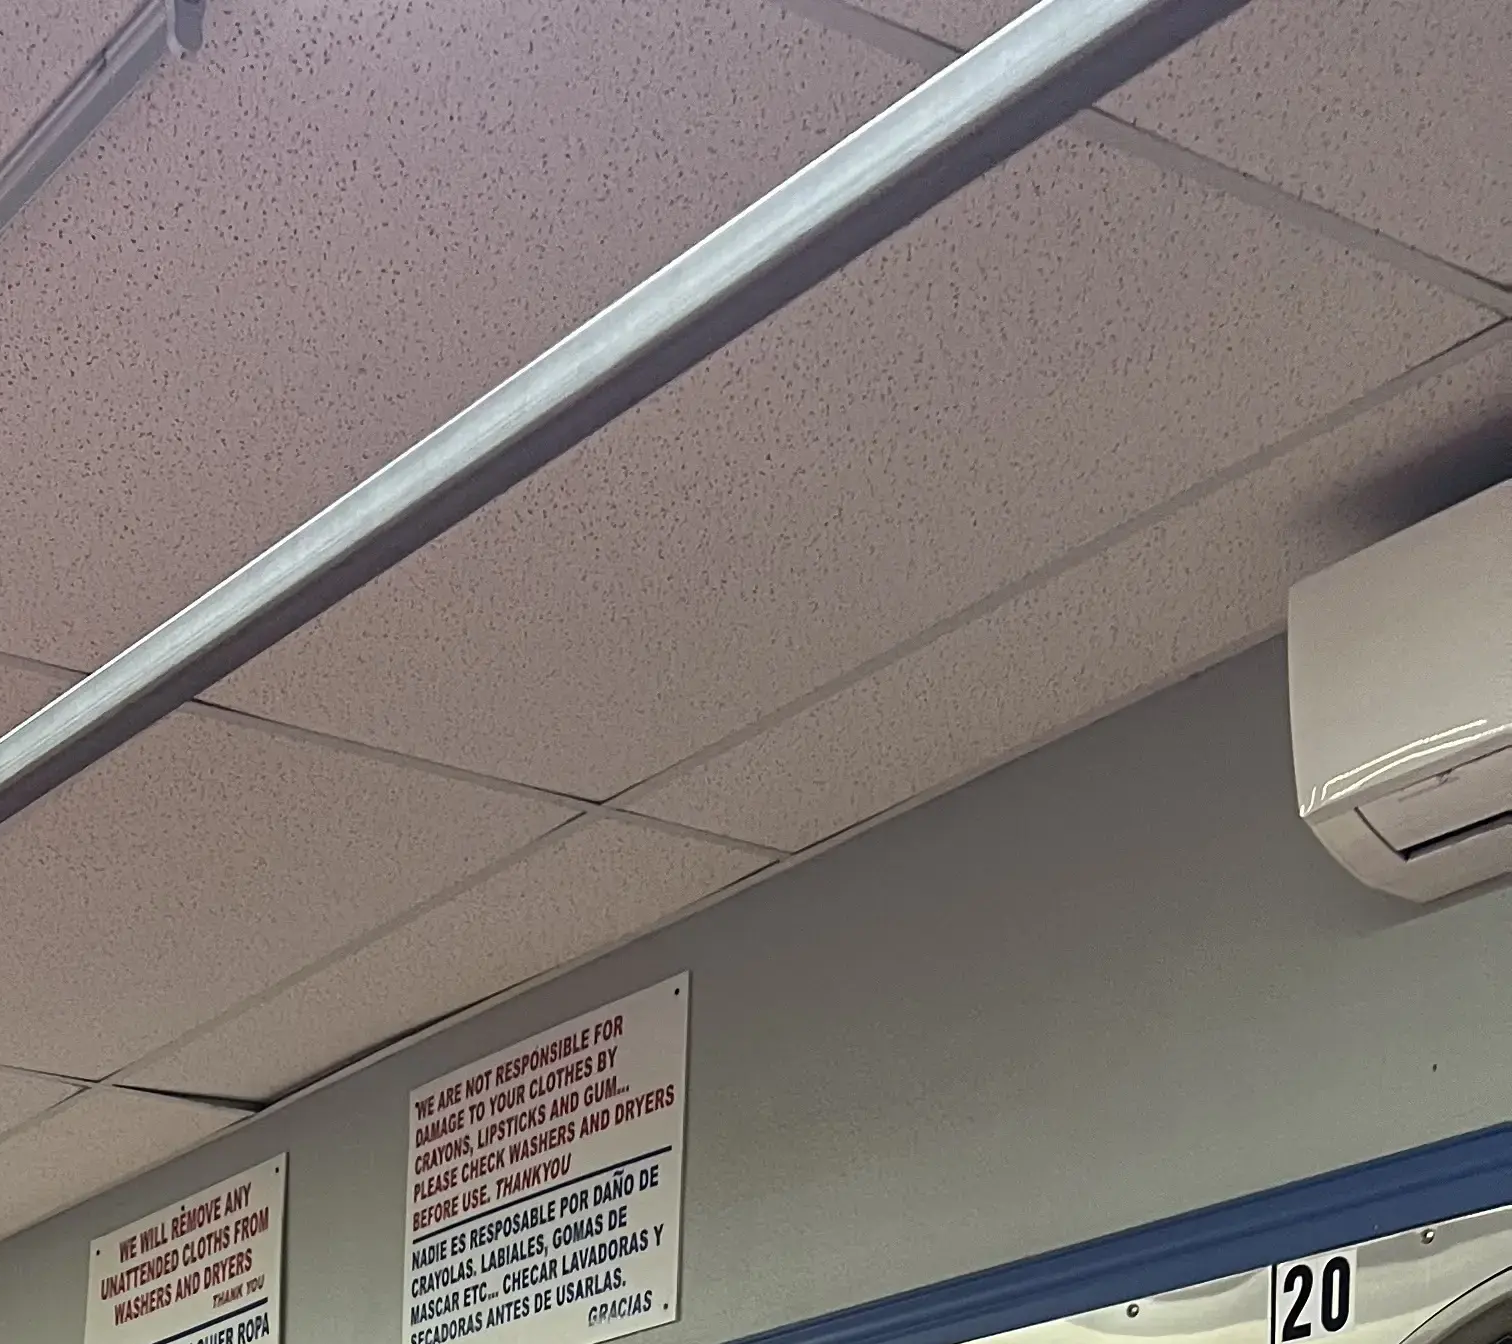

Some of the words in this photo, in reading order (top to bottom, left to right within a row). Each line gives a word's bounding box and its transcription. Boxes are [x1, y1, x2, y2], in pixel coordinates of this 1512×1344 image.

[415, 1098, 435, 1121] WE
[438, 1085, 462, 1110] ARE
[465, 1070, 492, 1095] NOT
[495, 1028, 590, 1085] RESPONSIBLE
[594, 1015, 624, 1045] FOR
[415, 1113, 465, 1148] DAMAGE
[469, 1101, 485, 1125] TO
[489, 1086, 526, 1116] YOUR
[529, 1056, 593, 1102] CLOTHES
[597, 1045, 619, 1074] BY
[414, 1170, 458, 1203] PLEASE
[461, 1151, 505, 1181] CHECK
[509, 1122, 575, 1163] WASHERS
[579, 1112, 610, 1141] AND
[614, 1084, 675, 1124] DRYERS
[415, 1137, 474, 1175] CRAYONS,
[478, 1108, 546, 1149] LIPSTICKS
[550, 1091, 579, 1120] AND
[583, 1076, 630, 1107] GUM...
[119, 1236, 137, 1263] WE
[140, 1225, 168, 1254] WILL
[171, 1202, 221, 1243] REMOVE
[225, 1182, 252, 1218] ANY
[412, 1239, 447, 1270] NADIE
[450, 1231, 467, 1257] ES
[469, 1195, 556, 1249] RESPOSABLE
[560, 1187, 589, 1218] POR
[593, 1170, 634, 1207] DAÑO
[639, 1165, 660, 1191] DE
[413, 1199, 459, 1232] BEFORE
[462, 1187, 490, 1213] USE.
[495, 1154, 572, 1199] THANKYOU
[101, 1251, 179, 1300] UNATTENDED
[182, 1226, 230, 1267] CLOTHS
[234, 1207, 269, 1245] FROM
[410, 1292, 460, 1326] MASCAR
[464, 1282, 499, 1308] ETC...
[503, 1256, 558, 1294] CHECAR
[562, 1230, 649, 1276] LAVADORAS
[654, 1224, 664, 1247] Y
[480, 1231, 549, 1274] LABIALES,
[552, 1213, 604, 1249] GOMAS
[608, 1206, 628, 1232] DE
[115, 1286, 172, 1326] WASHERS
[175, 1272, 200, 1302] AND
[204, 1248, 252, 1291] DRYERS
[486, 1297, 530, 1330] ANTES
[534, 1287, 552, 1312] DE
[556, 1268, 626, 1306] USARLAS.
[588, 1290, 653, 1327] GRACIAS
[1282, 1257, 1352, 1342] 20
